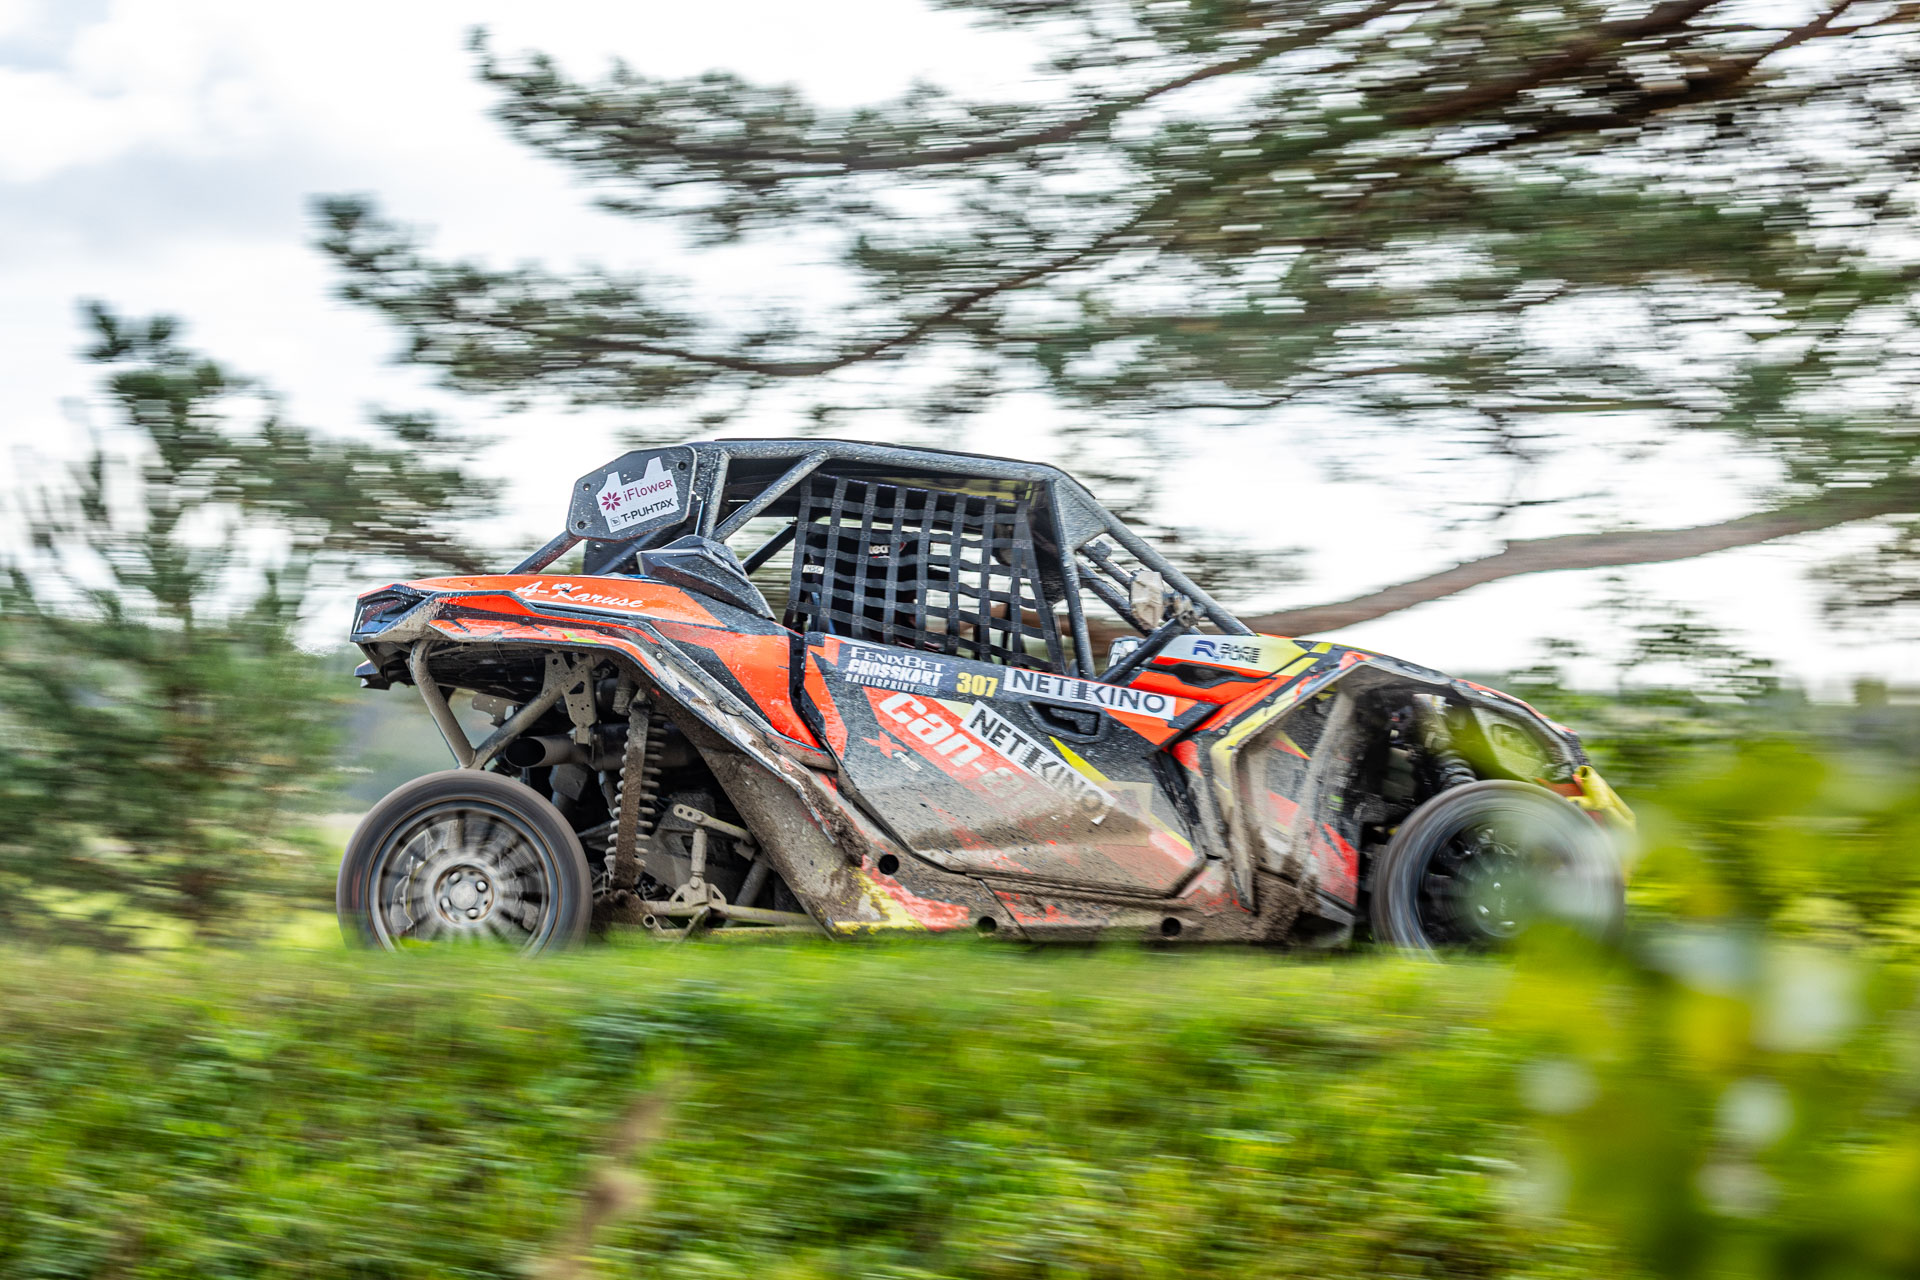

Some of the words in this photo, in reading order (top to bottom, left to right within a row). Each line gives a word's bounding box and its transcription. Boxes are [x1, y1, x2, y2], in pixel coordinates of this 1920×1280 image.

[621, 498, 674, 522] T-PUHTAX
[845, 673, 916, 693] RALLISPRINT
[848, 658, 943, 687] CROSSKART
[956, 672, 999, 698] 307
